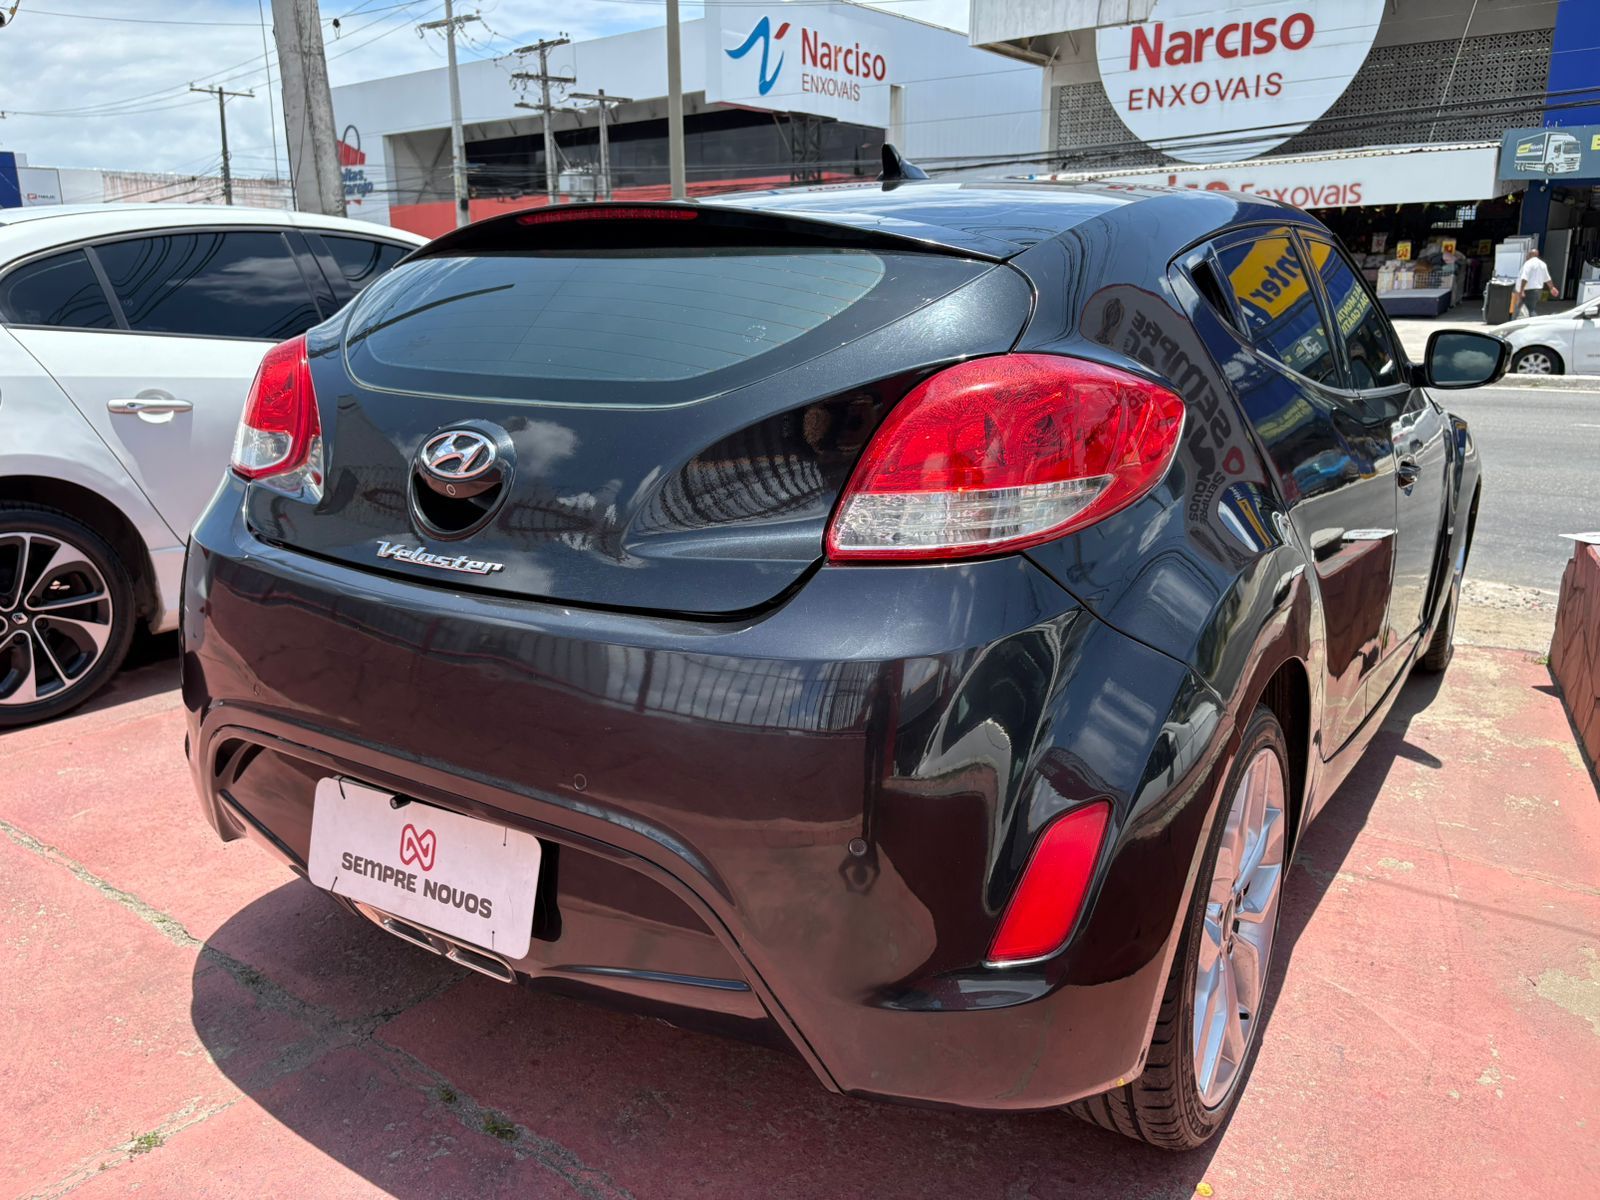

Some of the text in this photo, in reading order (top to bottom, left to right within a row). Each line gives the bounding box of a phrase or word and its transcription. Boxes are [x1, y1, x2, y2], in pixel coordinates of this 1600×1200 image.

[801, 27, 887, 81] Narciso
[1129, 12, 1315, 71] Narciso
[801, 73, 861, 102] ENXOVAIS
[1128, 72, 1283, 111] ENXOVAIS
[376, 540, 505, 575] Veloster
[341, 852, 418, 893] SEMPRE
